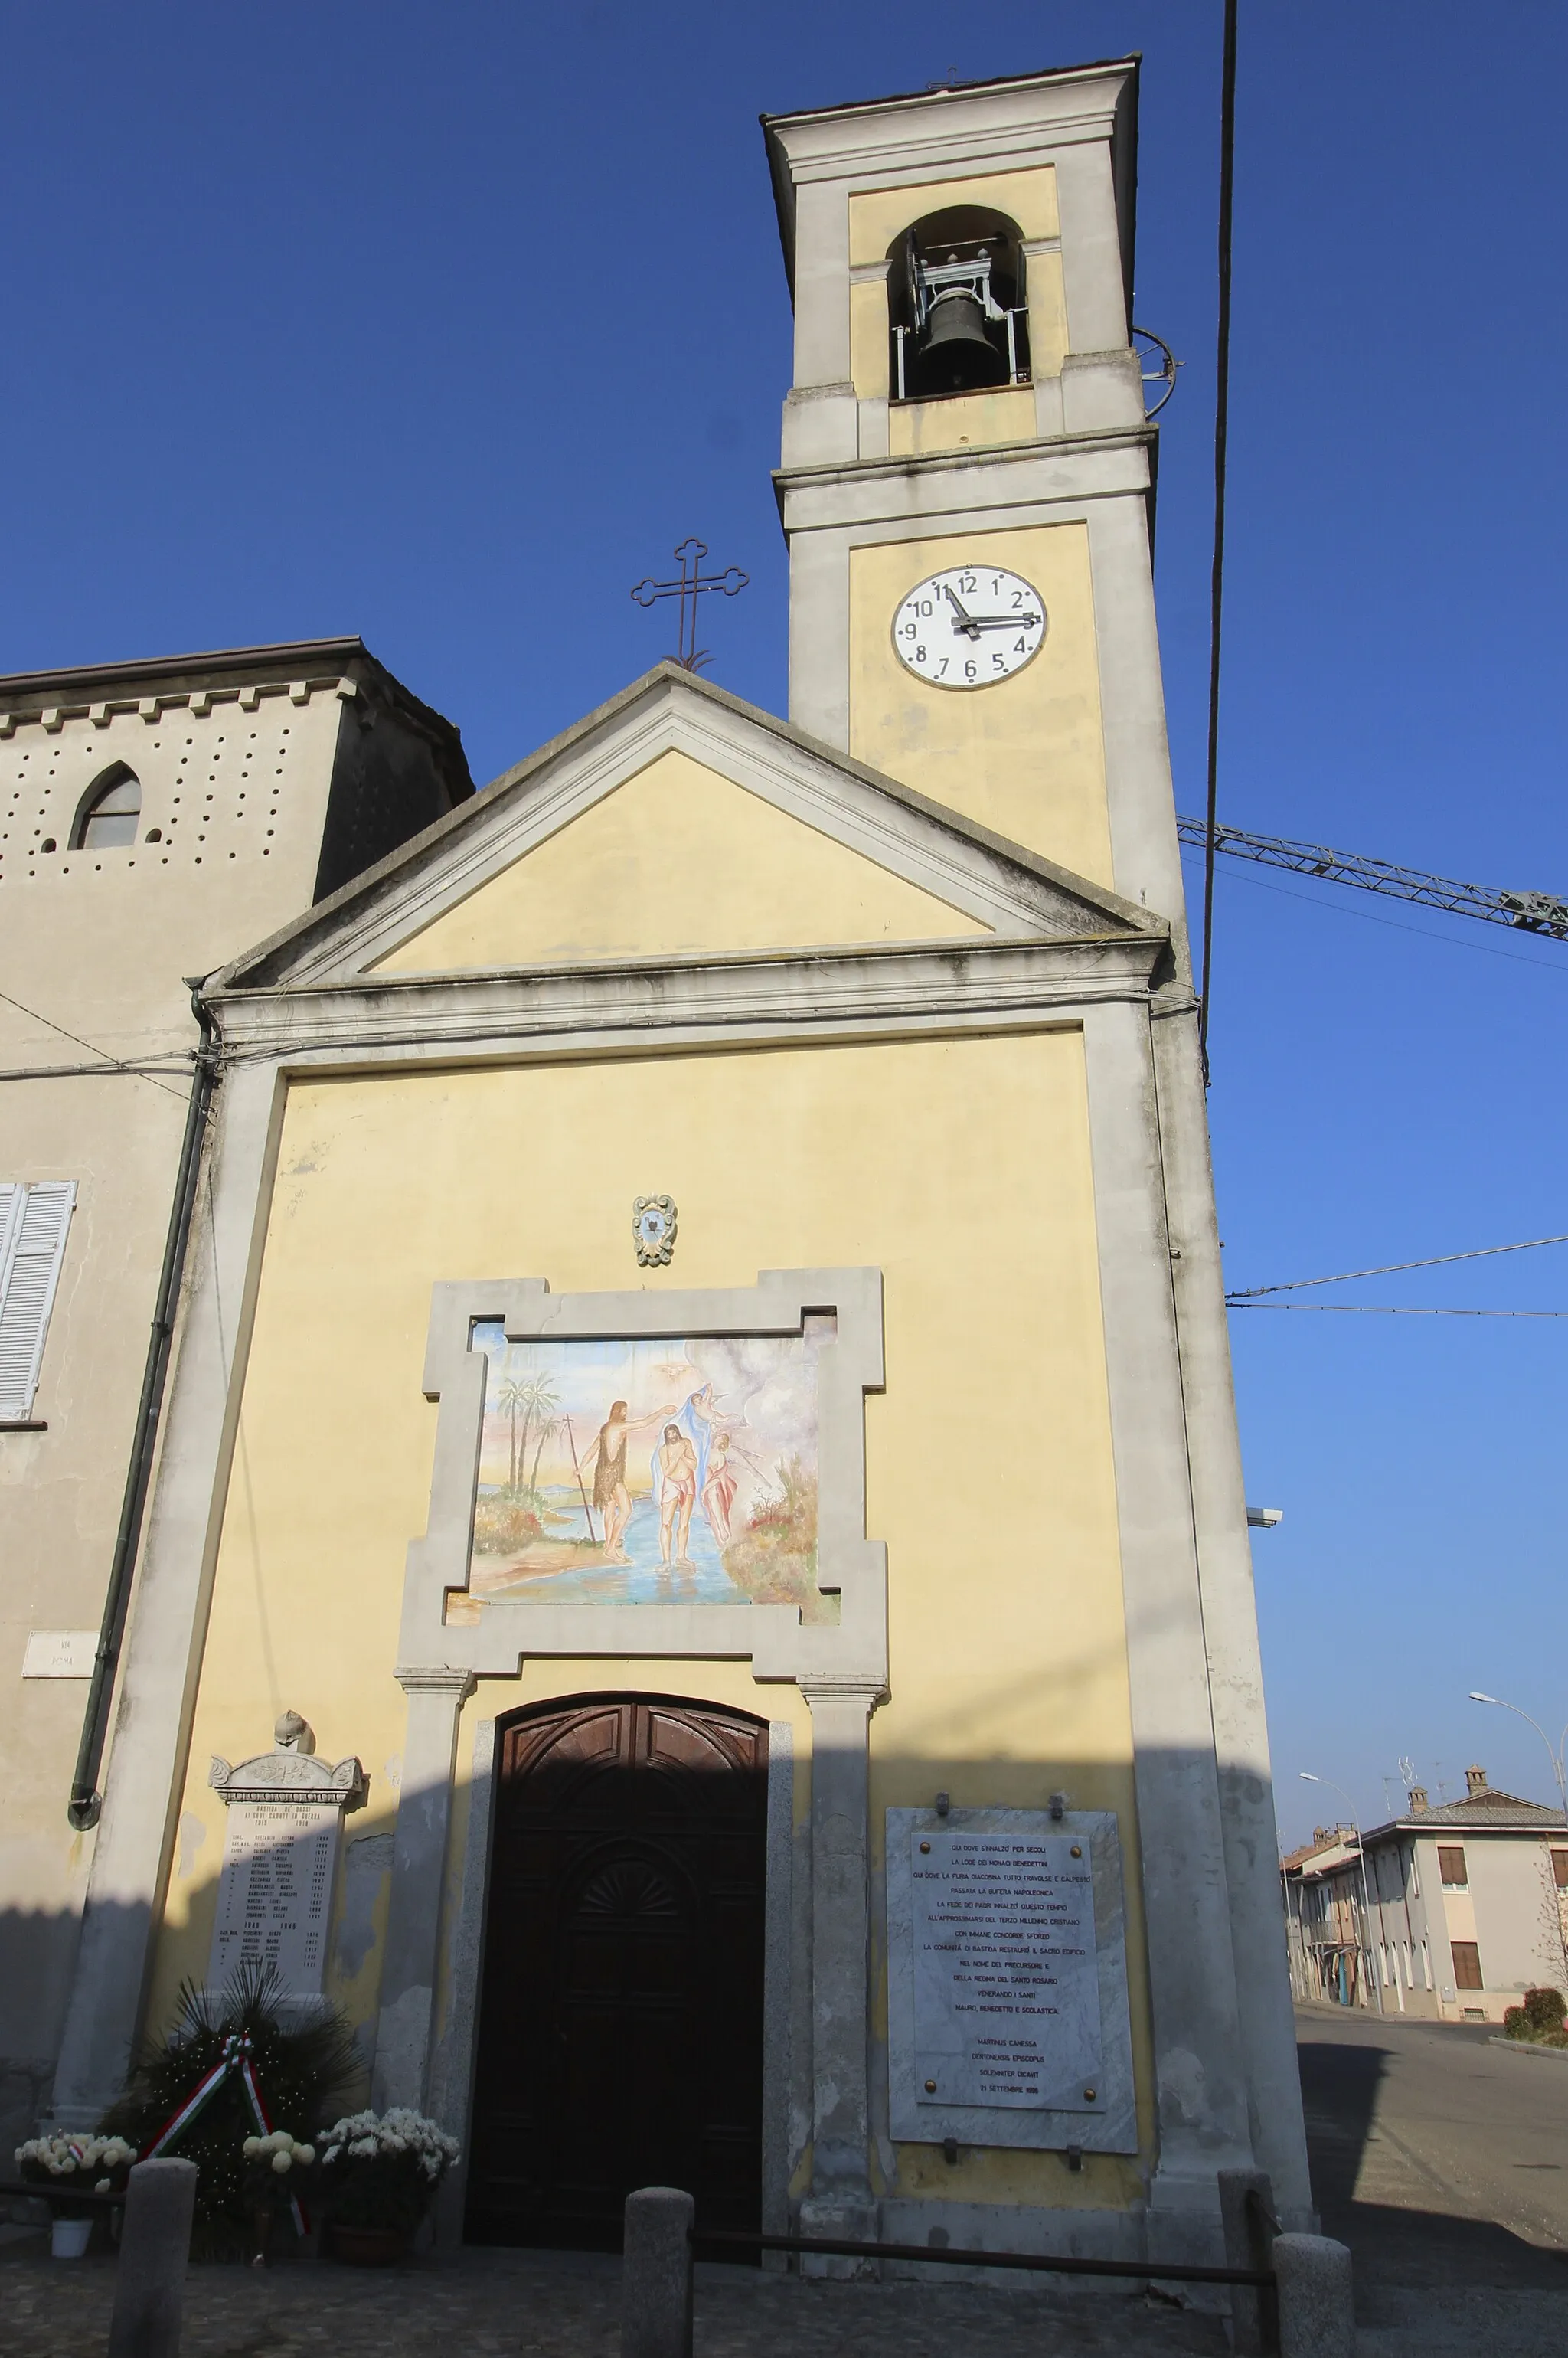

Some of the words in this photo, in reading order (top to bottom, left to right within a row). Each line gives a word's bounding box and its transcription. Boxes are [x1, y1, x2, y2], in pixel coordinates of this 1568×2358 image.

[934, 584, 950, 601] 11
[958, 576, 977, 594] 12
[991, 578, 998, 595] 1
[1011, 591, 1023, 609] 2
[913, 600, 933, 618] 10
[905, 623, 917, 640] 9
[1013, 636, 1025, 653] 4
[916, 646, 926, 662] 8
[992, 653, 1005, 671] 5
[939, 658, 949, 675] 7
[965, 660, 976, 677] 6
[1004, 1961, 1043, 1970] PRECURSORE
[972, 2052, 1011, 2061] DERTONENSIS
[1012, 2055, 1045, 2063] EPISCOPUS
[989, 2085, 1024, 2093] SETTEMBRE
